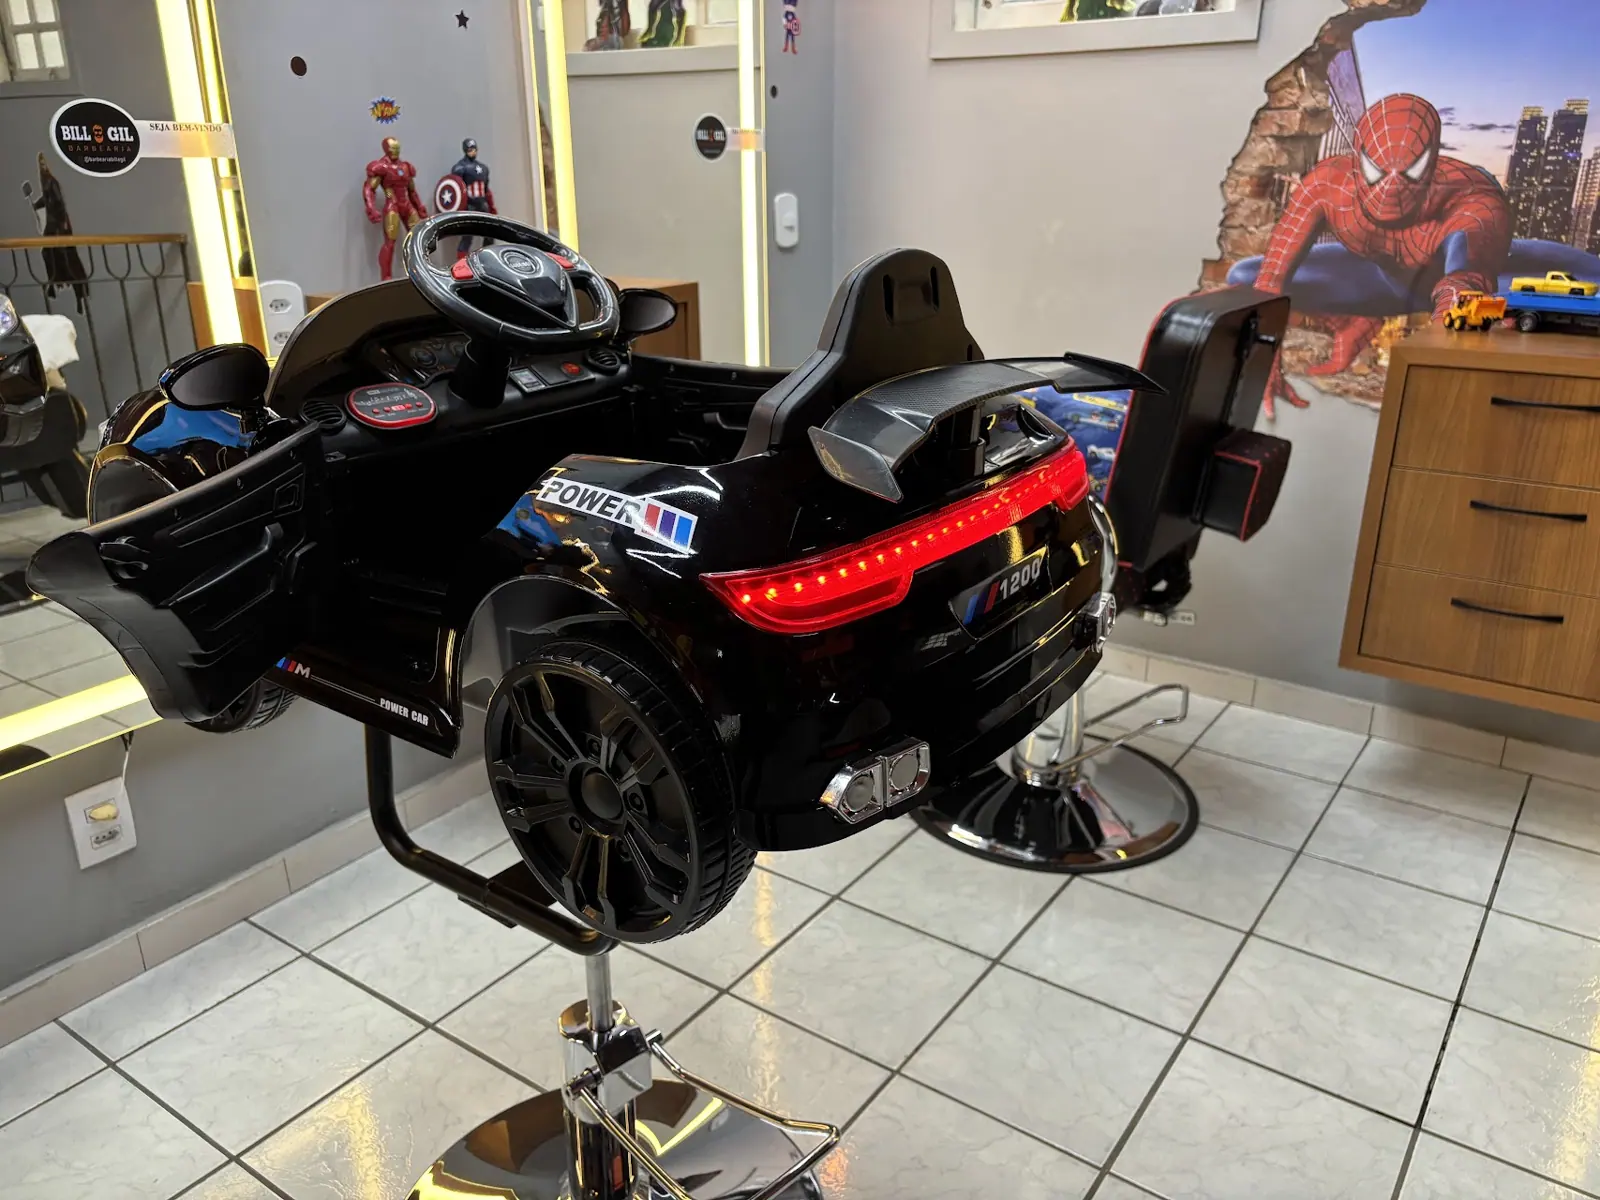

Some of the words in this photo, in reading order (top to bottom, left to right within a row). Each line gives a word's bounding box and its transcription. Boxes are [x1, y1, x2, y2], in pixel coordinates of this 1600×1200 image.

[61, 125, 92, 141] BILL
[107, 126, 134, 142] GIL
[149, 122, 170, 132] SEJA
[172, 123, 222, 133] BEM-VINDO
[542, 480, 641, 524] POWER
[1000, 558, 1040, 600] 1200
[294, 663, 311, 679] M
[380, 698, 409, 718] POWER
[411, 710, 429, 726] CAR
